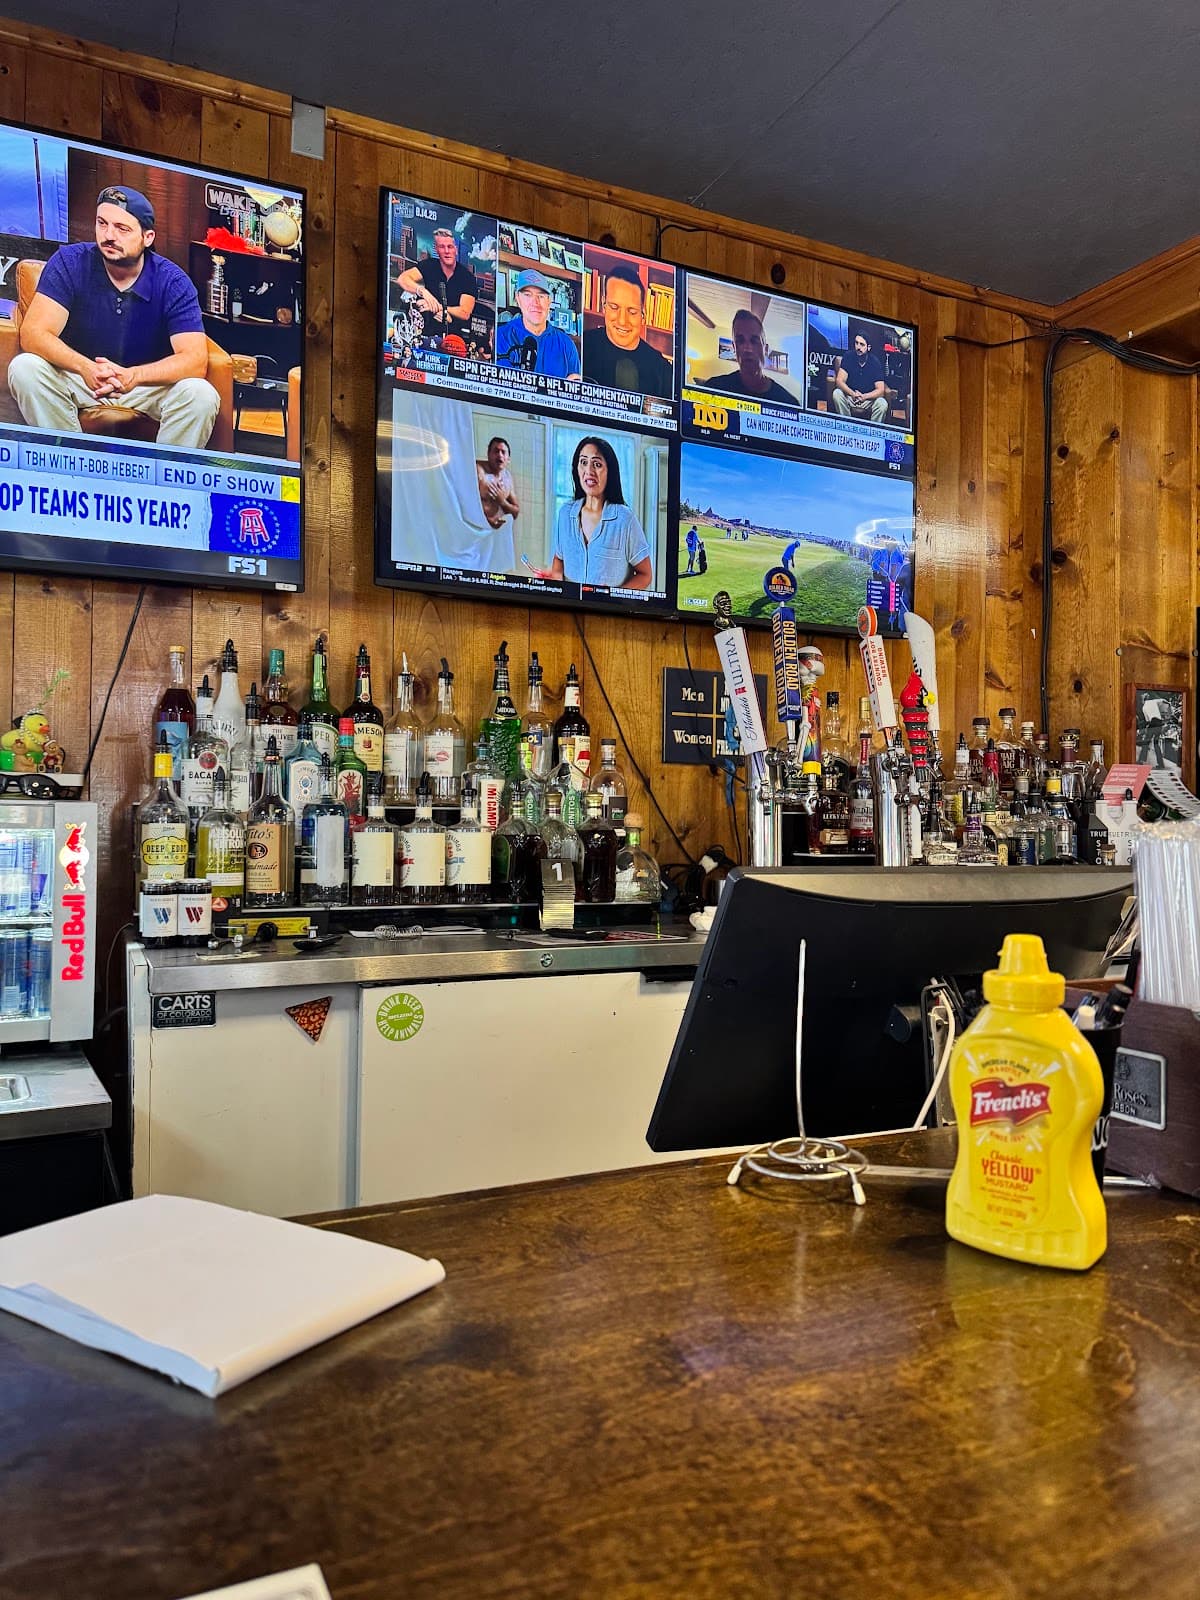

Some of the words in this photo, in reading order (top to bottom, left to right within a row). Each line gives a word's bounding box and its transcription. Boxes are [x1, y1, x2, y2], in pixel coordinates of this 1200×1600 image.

[425, 354, 441, 365] KIRK
[809, 351, 836, 366] ONLY
[453, 360, 479, 374] ESPN
[480, 364, 498, 377] CFB
[499, 368, 538, 386] ANALYST
[539, 375, 546, 387] &
[547, 377, 563, 391] NFL
[564, 381, 580, 394] TNF
[581, 385, 641, 406] COMMENTATOR
[465, 373, 480, 382] HOST
[481, 375, 488, 384] OF
[489, 376, 512, 388] COLLEGE
[436, 377, 485, 393] Commanders
[486, 386, 492, 394] @
[494, 388, 511, 398] 7PM
[556, 400, 583, 412] Broncos
[592, 408, 616, 419] Atlanta
[617, 411, 641, 423] Falcons
[547, 389, 558, 397] THE
[603, 399, 628, 410] FOOTBALL
[746, 417, 757, 429] CAN
[758, 419, 775, 433] NOTRE
[790, 425, 813, 441] COMPETE
[813, 430, 827, 443] WITH
[827, 433, 837, 444] TOP
[837, 435, 853, 449] TEAMS
[854, 438, 865, 451] THIS
[26, 450, 46, 467] TBH
[50, 453, 76, 471] WITH
[79, 456, 109, 475] T-BOB
[112, 461, 150, 480] HEBERT
[888, 462, 901, 471] FS1
[164, 467, 197, 485] END
[202, 472, 222, 488] OF
[227, 476, 275, 495] SHOW
[0, 482, 24, 512] OP
[29, 485, 89, 520] TEAMS
[94, 493, 132, 524] THIS
[137, 498, 191, 530] YEAR?
[228, 555, 268, 576] FS1
[772, 612, 784, 666] GOLDEN
[782, 620, 797, 660] GOLDEN
[869, 639, 877, 654] BOY
[724, 636, 745, 687] ULTRA
[871, 655, 883, 687] COUNTRY
[877, 647, 888, 679] BREWING
[775, 669, 787, 705] ROAD
[785, 663, 799, 690] ROAD
[681, 687, 705, 702] Men
[354, 725, 384, 737] AMESON
[672, 729, 713, 745] Women
[188, 771, 217, 779] BACAR
[486, 800, 497, 832] CAMPO
[568, 795, 576, 827] RNITOS
[1089, 830, 1108, 838] TRUE
[146, 844, 165, 853] DEEP
[551, 862, 563, 881] 1
[159, 994, 211, 1011] CARTS
[378, 995, 401, 1017] DRINK
[402, 994, 422, 1013] BEER
[169, 1010, 212, 1019] COLORADO
[377, 1019, 395, 1038] HELP
[393, 1014, 424, 1041] ANIMALS
[972, 1089, 1042, 1116] French's
[1111, 1101, 1137, 1115] RBON
[982, 1158, 1034, 1185] YELLOW
[985, 1177, 1029, 1192] MUSTARD
